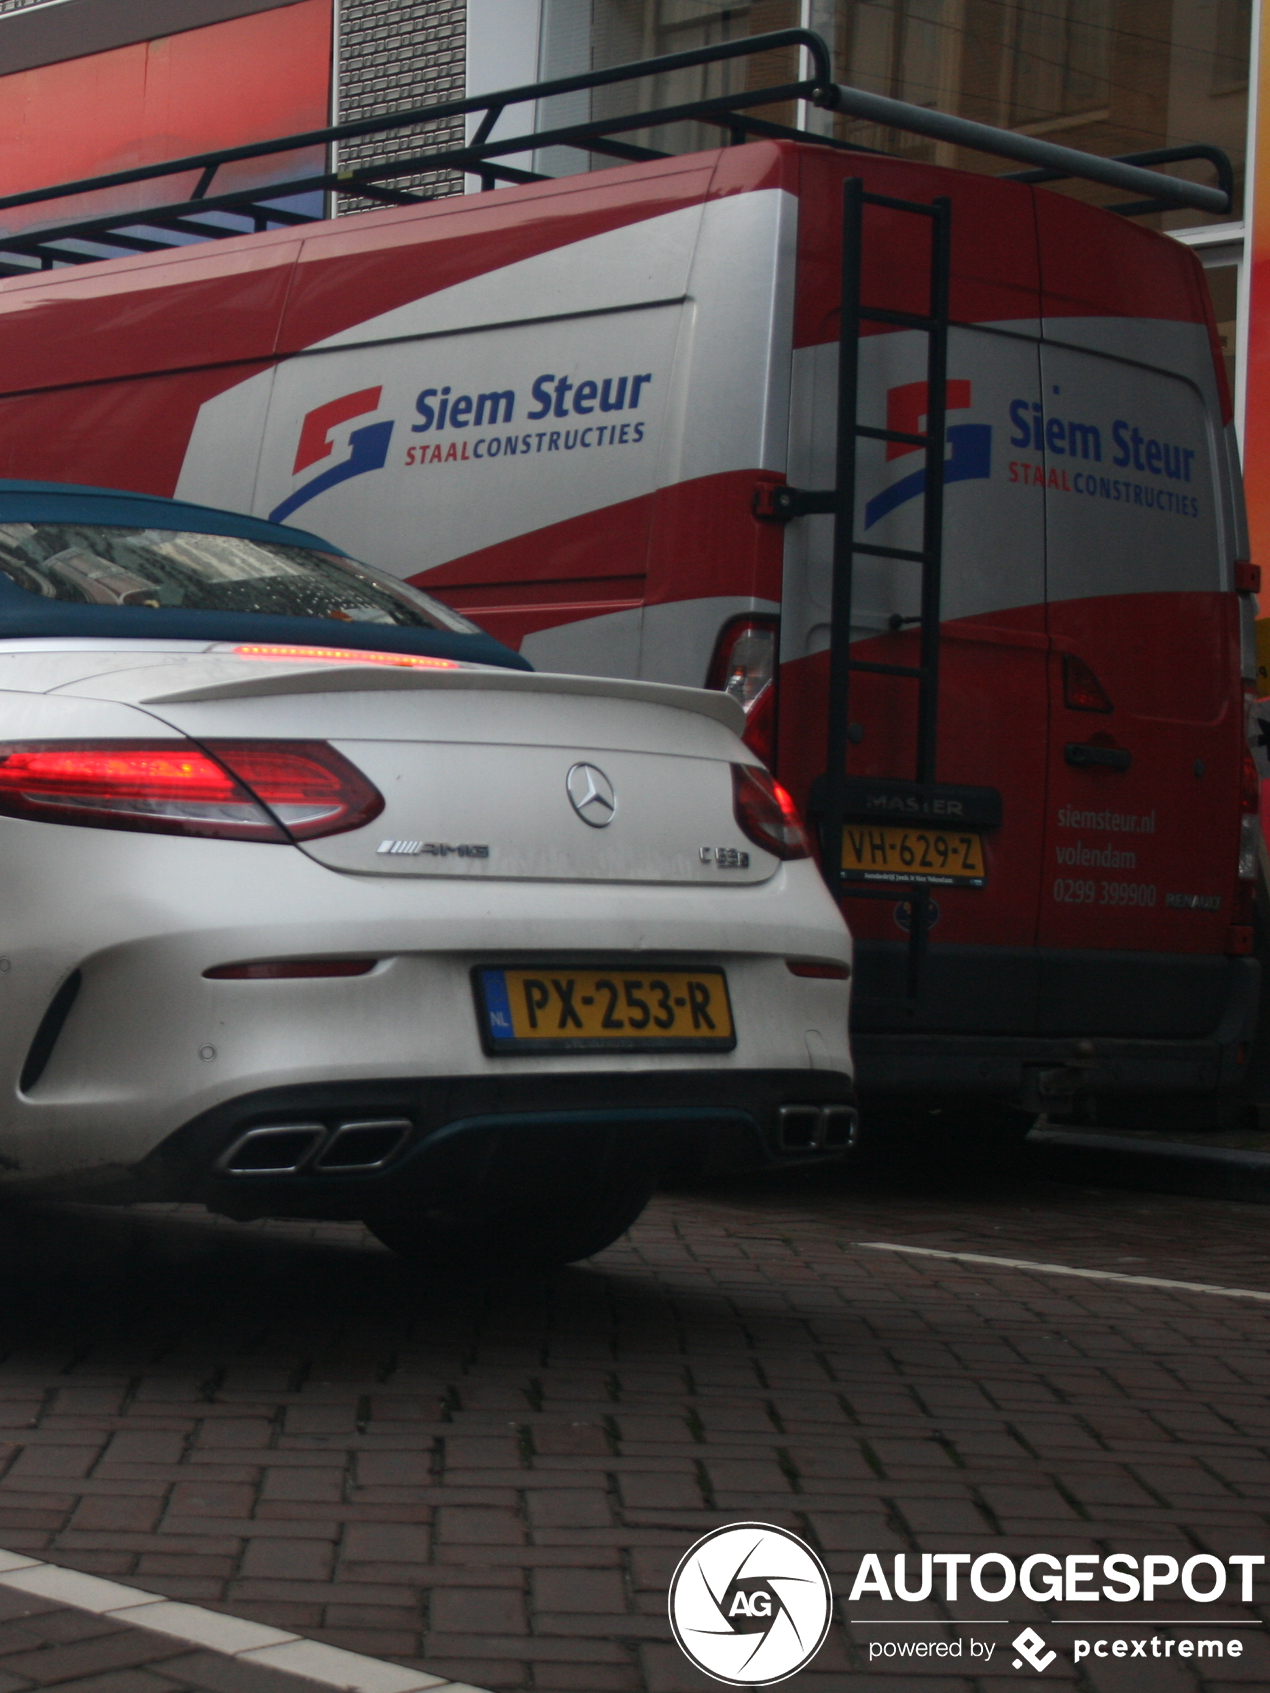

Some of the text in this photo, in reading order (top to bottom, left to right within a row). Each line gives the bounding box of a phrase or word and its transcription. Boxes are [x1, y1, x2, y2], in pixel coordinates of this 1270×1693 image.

[411, 373, 652, 433] Siem Steur
[404, 421, 646, 466] STAALCONSTRUCTIES
[1009, 398, 1195, 483] Siem Steur
[1009, 461, 1199, 518] STAALCONSTRUCTIES
[1057, 804, 1156, 833] siemsteur.nl
[848, 830, 976, 869] VH-629-Z
[1055, 841, 1137, 869] volendam
[1053, 878, 1157, 907] 0299 399900
[1166, 892, 1222, 911] RENAULT
[490, 1011, 509, 1027] NL
[523, 979, 716, 1030] PX-253-R
